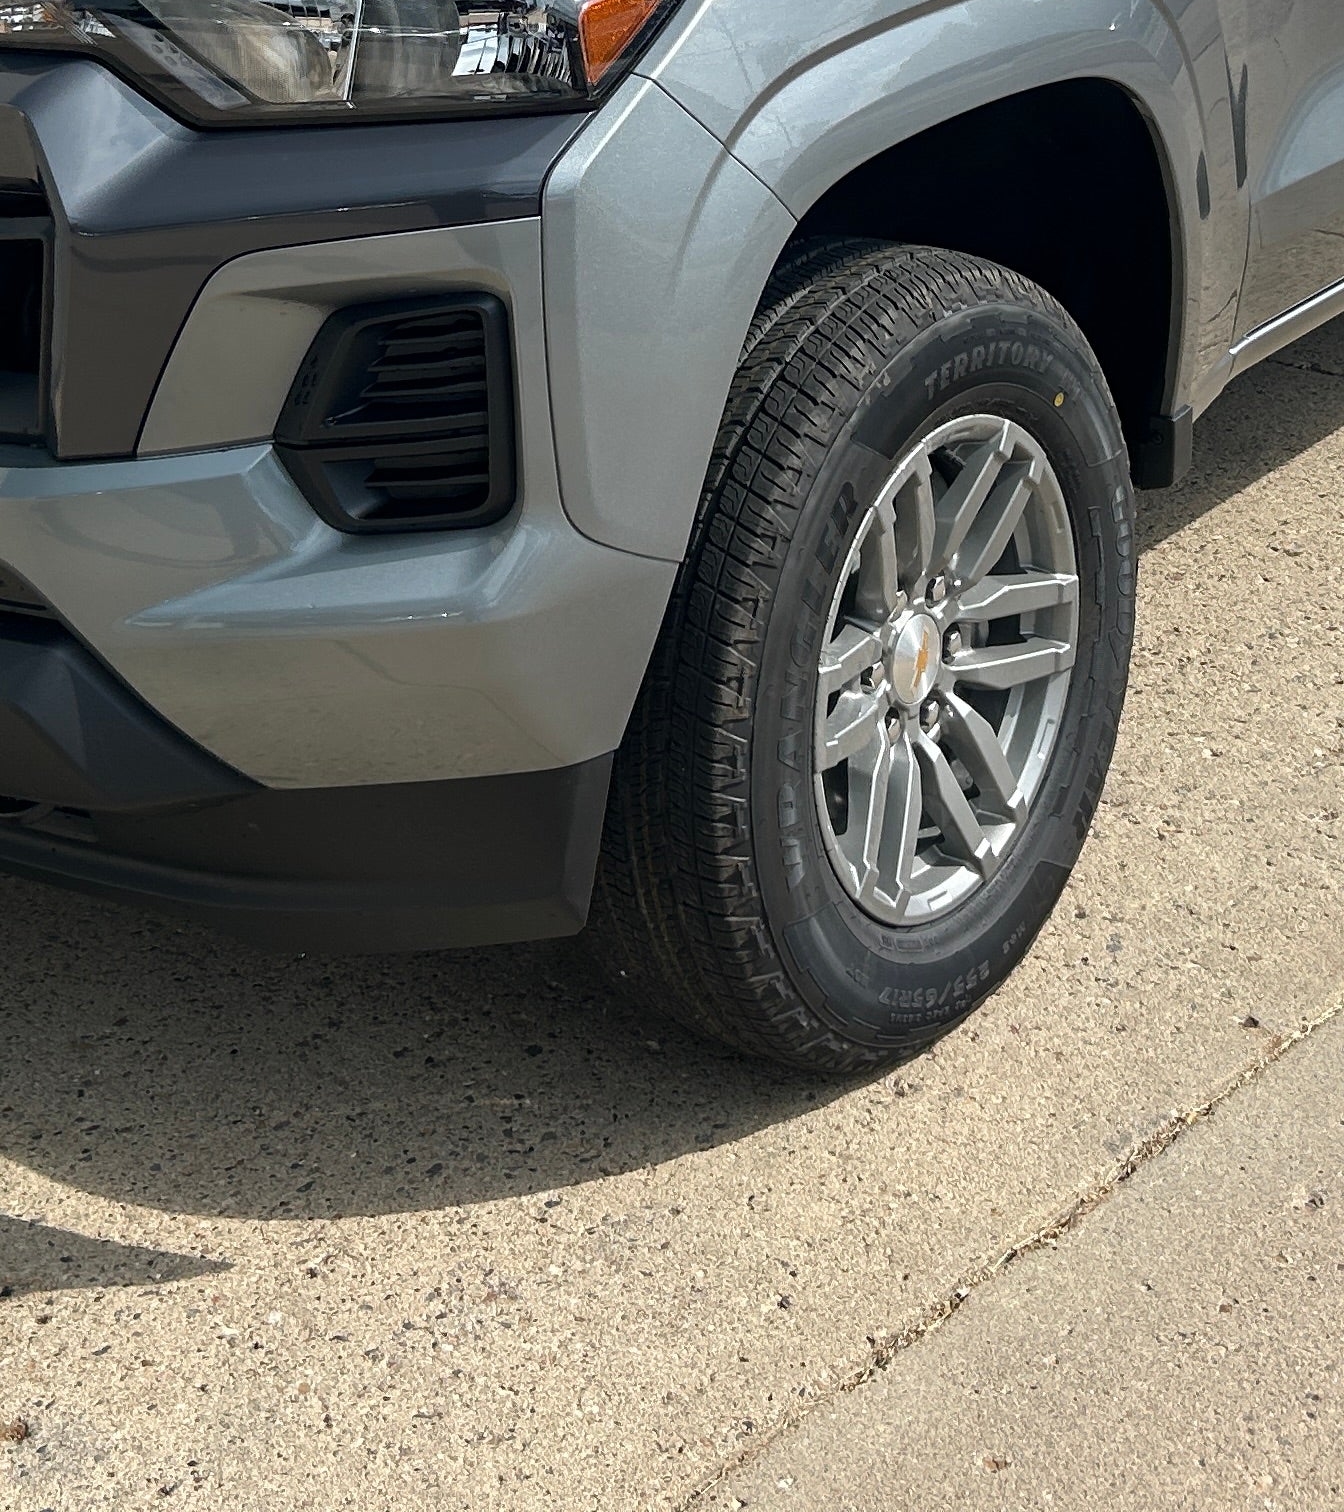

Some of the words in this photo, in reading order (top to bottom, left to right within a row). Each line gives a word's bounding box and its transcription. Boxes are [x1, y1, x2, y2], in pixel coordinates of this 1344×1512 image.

[924, 340, 1055, 401] TERRITORY
[776, 480, 858, 889] WRANGLER
[878, 959, 990, 1009] 255/65R17
